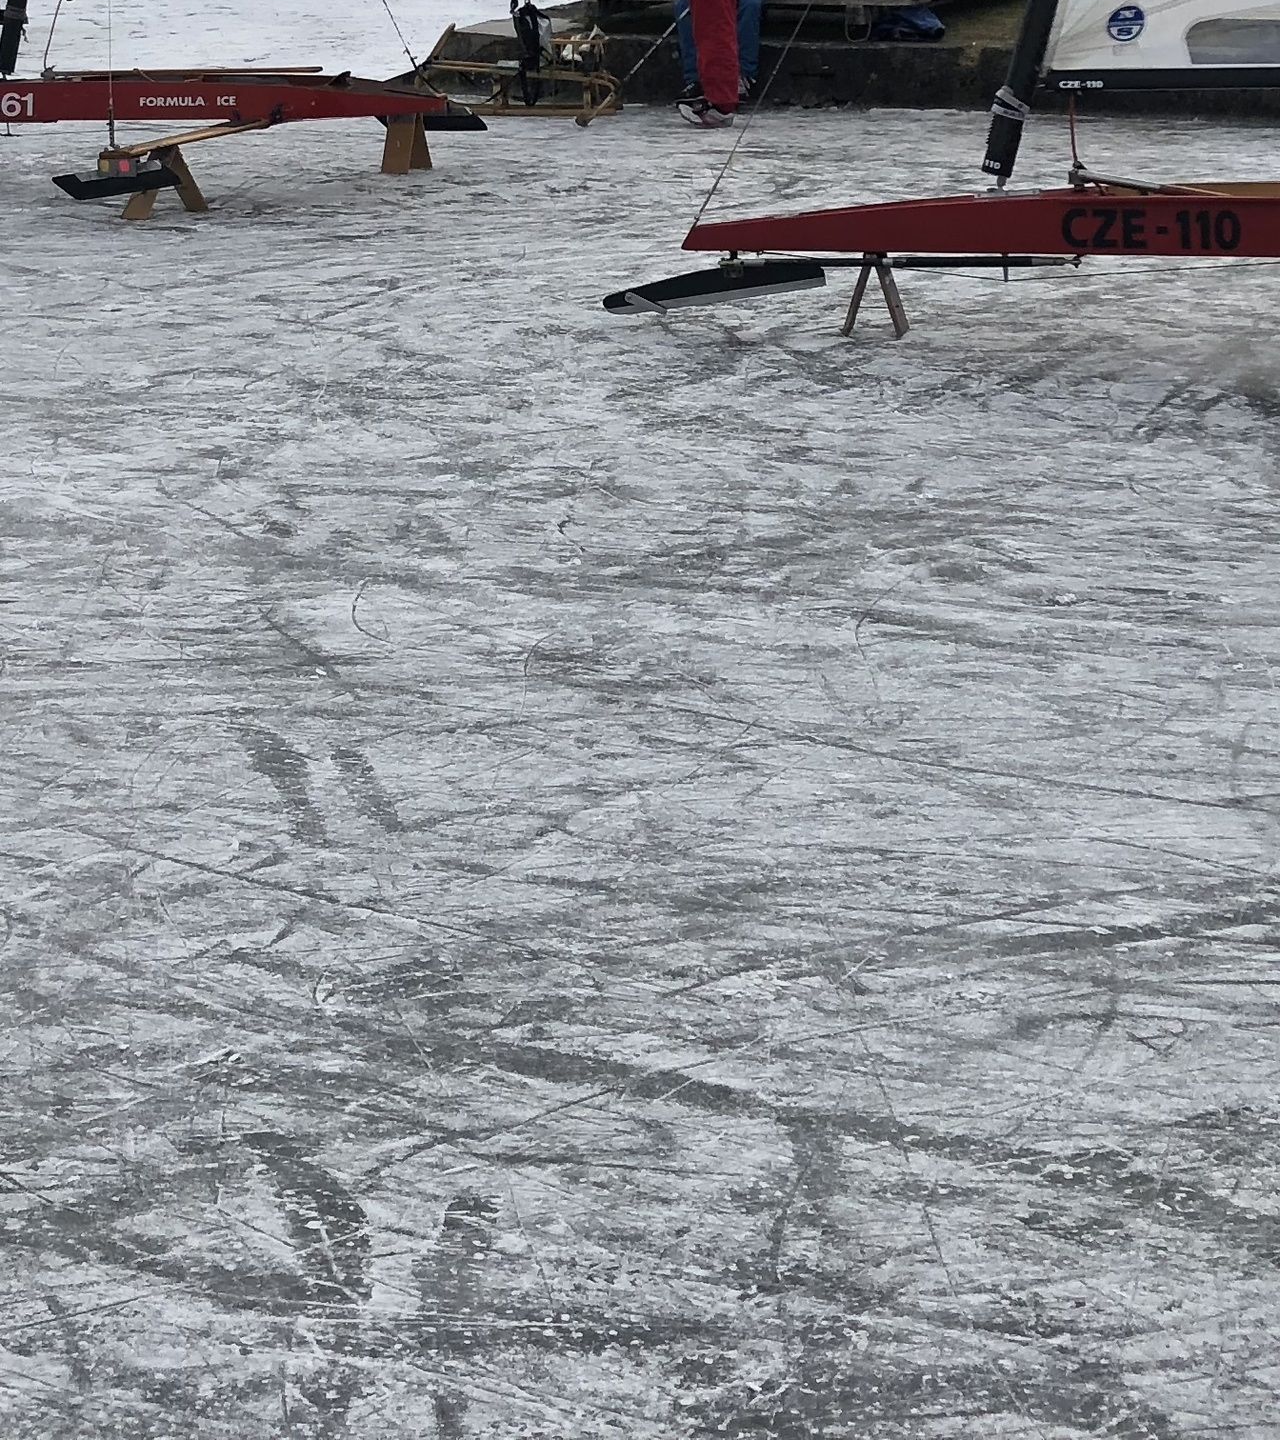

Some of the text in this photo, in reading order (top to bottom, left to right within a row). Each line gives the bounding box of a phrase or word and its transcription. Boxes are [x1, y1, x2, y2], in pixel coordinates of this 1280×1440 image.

[139, 95, 237, 107] FORMULA ICE
[984, 159, 1001, 170] 110
